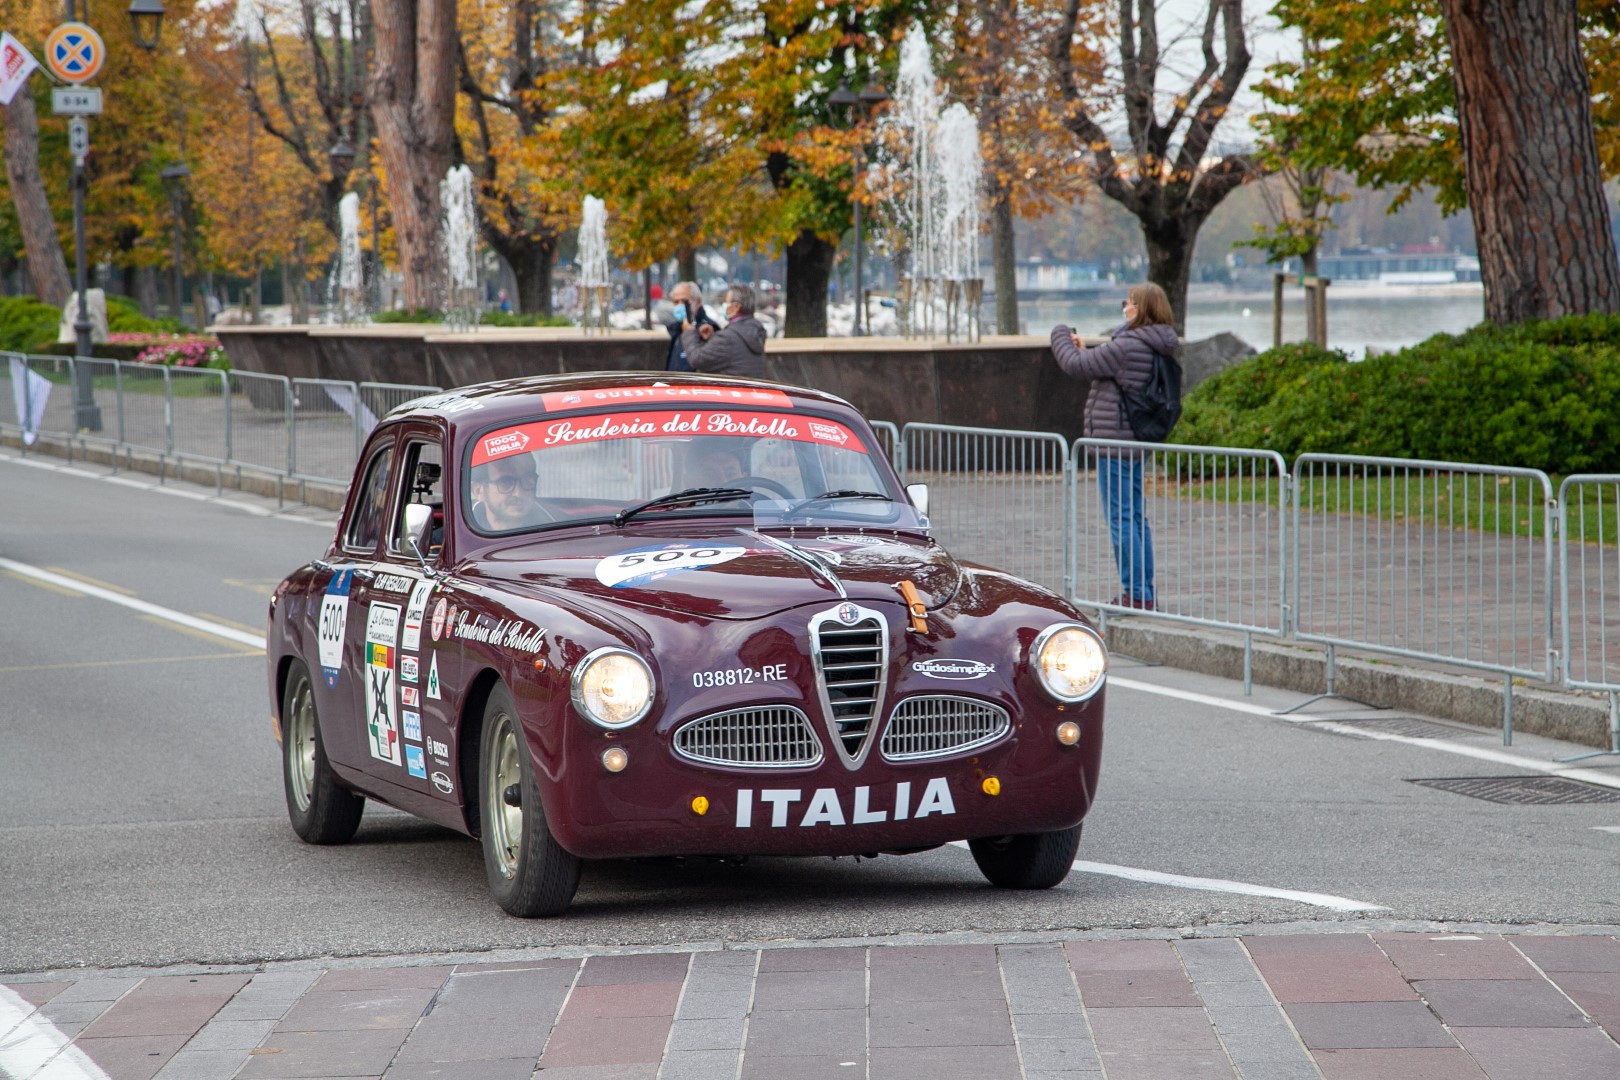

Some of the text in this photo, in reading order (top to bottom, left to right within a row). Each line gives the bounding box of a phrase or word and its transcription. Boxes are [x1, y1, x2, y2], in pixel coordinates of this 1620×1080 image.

[594, 388, 655, 399] GUEST
[544, 413, 799, 444] Scuderia del Portello
[813, 424, 838, 434] 1000
[814, 430, 843, 441] MIGLIA
[490, 435, 517, 447] 1000
[490, 440, 521, 454] MIGLIA
[618, 549, 721, 568] 500
[323, 603, 342, 642] 500
[454, 609, 490, 643] Scuderia
[488, 618, 512, 646] del
[503, 620, 549, 654] Portello
[912, 661, 996, 674] Guidosimplex
[433, 740, 449, 758] BOSCH
[735, 776, 956, 828] ITALIA
